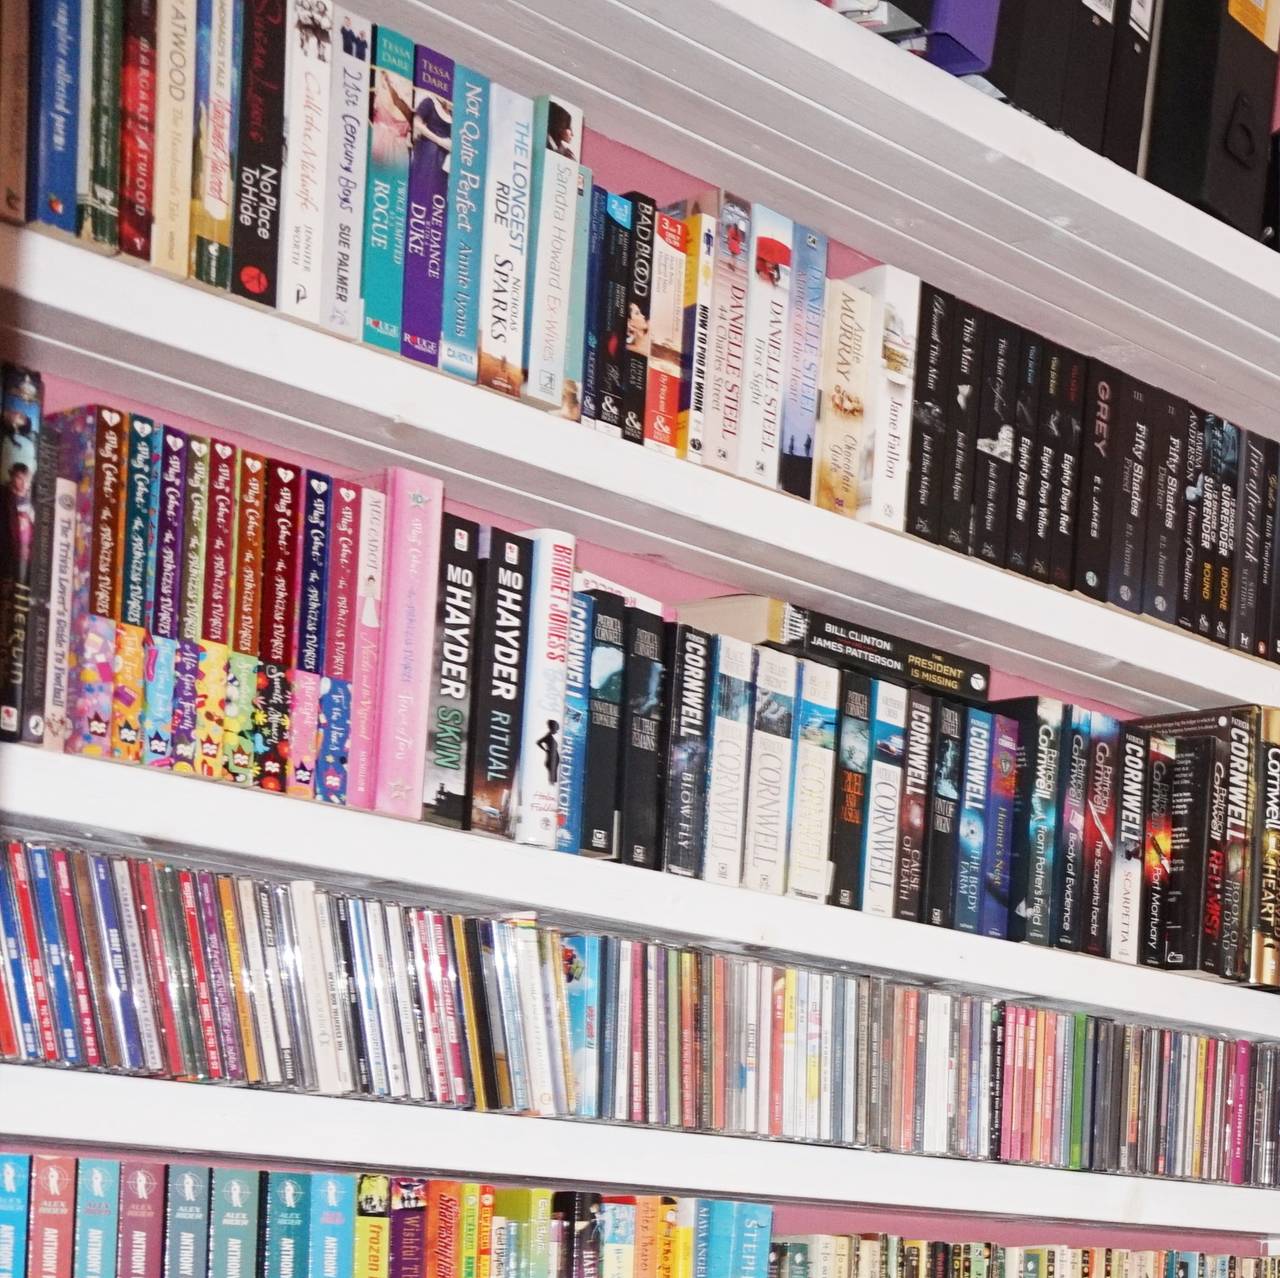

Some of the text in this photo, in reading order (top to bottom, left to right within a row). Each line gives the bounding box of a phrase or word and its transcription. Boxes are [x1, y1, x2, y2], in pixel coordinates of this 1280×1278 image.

[169, 7, 188, 101] ATWOOD
[422, 59, 451, 80] TESSA
[371, 178, 391, 249] ROGUE
[455, 83, 483, 338] Not Quite Perfect Annie Lyons
[494, 180, 511, 228] RIDE
[510, 121, 530, 256] THE LONGEST
[335, 223, 352, 303] SUE PALMER
[409, 202, 427, 257] DUKE
[427, 194, 446, 279] ONE DANCE
[491, 255, 515, 344] SPARKS
[510, 276, 523, 333] NICHOLAS
[693, 305, 709, 413] HOW TO POO AT WORK
[835, 292, 858, 384] MURRAY
[760, 301, 785, 450] DANIELLE STEEL
[1092, 381, 1112, 457] GREY
[1090, 495, 1102, 538] JAMES
[1164, 434, 1181, 529] Fifty Shades
[1218, 483, 1232, 557] SURRENDER
[447, 563, 473, 586] MO
[498, 567, 523, 590] MO
[551, 543, 573, 602] BRIDGET
[1219, 566, 1229, 613] UNDONE
[440, 583, 472, 701] HAYDER
[491, 588, 524, 702] HAYDER
[810, 635, 904, 671] JAMES PATTERSON
[824, 622, 891, 651] BILL CLINTON
[907, 654, 965, 680] PRESIDENT
[681, 640, 708, 738] CORNWELL
[910, 667, 960, 690] IS MISSING
[433, 706, 464, 771] SKIN
[487, 708, 513, 783] RITUAL
[906, 710, 931, 797] CORNWELL
[965, 726, 989, 809] CORNWELL
[1034, 724, 1054, 800] Cornwell
[557, 735, 574, 817] PREDATOR
[678, 772, 694, 851] BLOW FLY
[1121, 742, 1144, 842] CORNWELL
[870, 780, 898, 892] CORNWELL
[899, 834, 912, 901] OF DEATH
[909, 848, 920, 892] CAUSE
[957, 857, 972, 898] FARM
[1261, 865, 1277, 928] HEART
[284, 1049, 294, 1080] PHILIPS
[43, 1227, 59, 1272] ANTHONY
[369, 1224, 385, 1274] frozen
